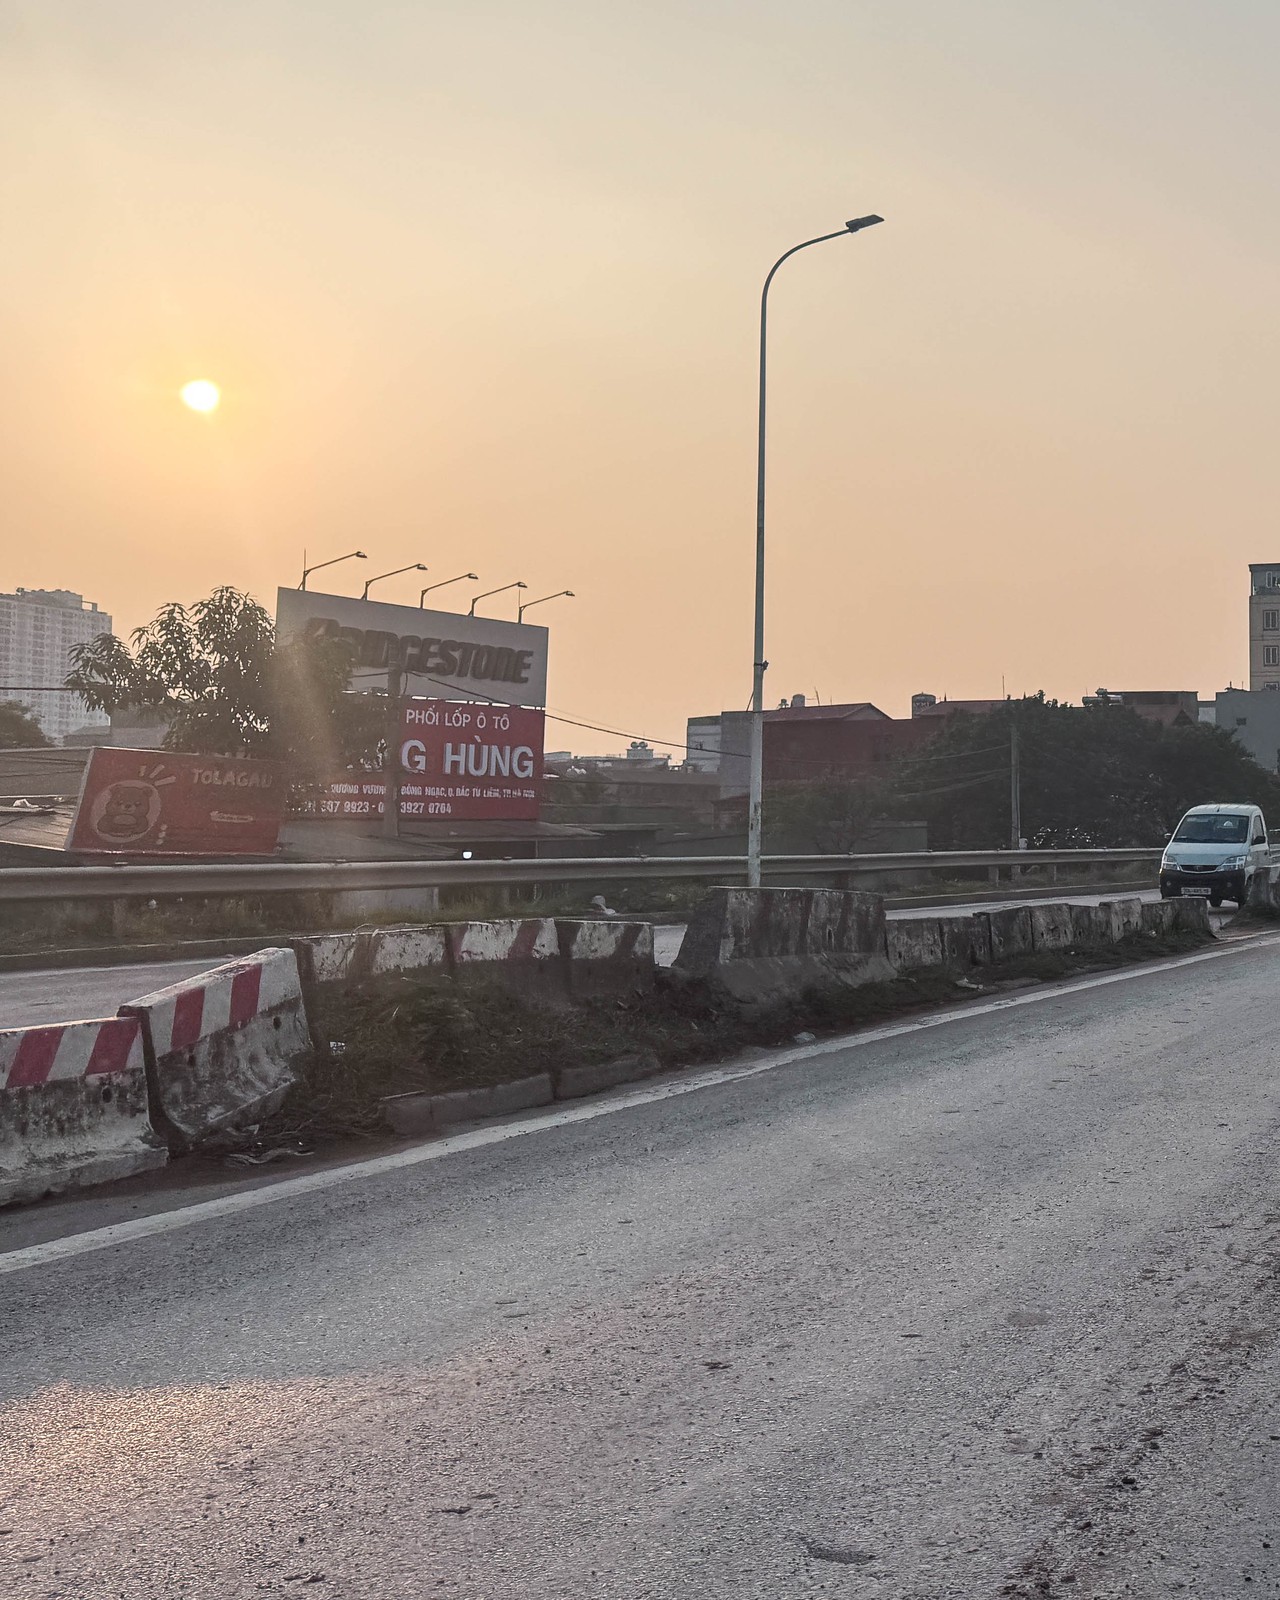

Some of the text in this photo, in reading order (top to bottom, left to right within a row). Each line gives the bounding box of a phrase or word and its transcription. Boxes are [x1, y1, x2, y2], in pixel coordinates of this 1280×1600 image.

[445, 707, 471, 727] LỐP
[476, 712, 487, 729] Ô
[492, 713, 510, 731] TÔ
[443, 735, 534, 778] HÙNG
